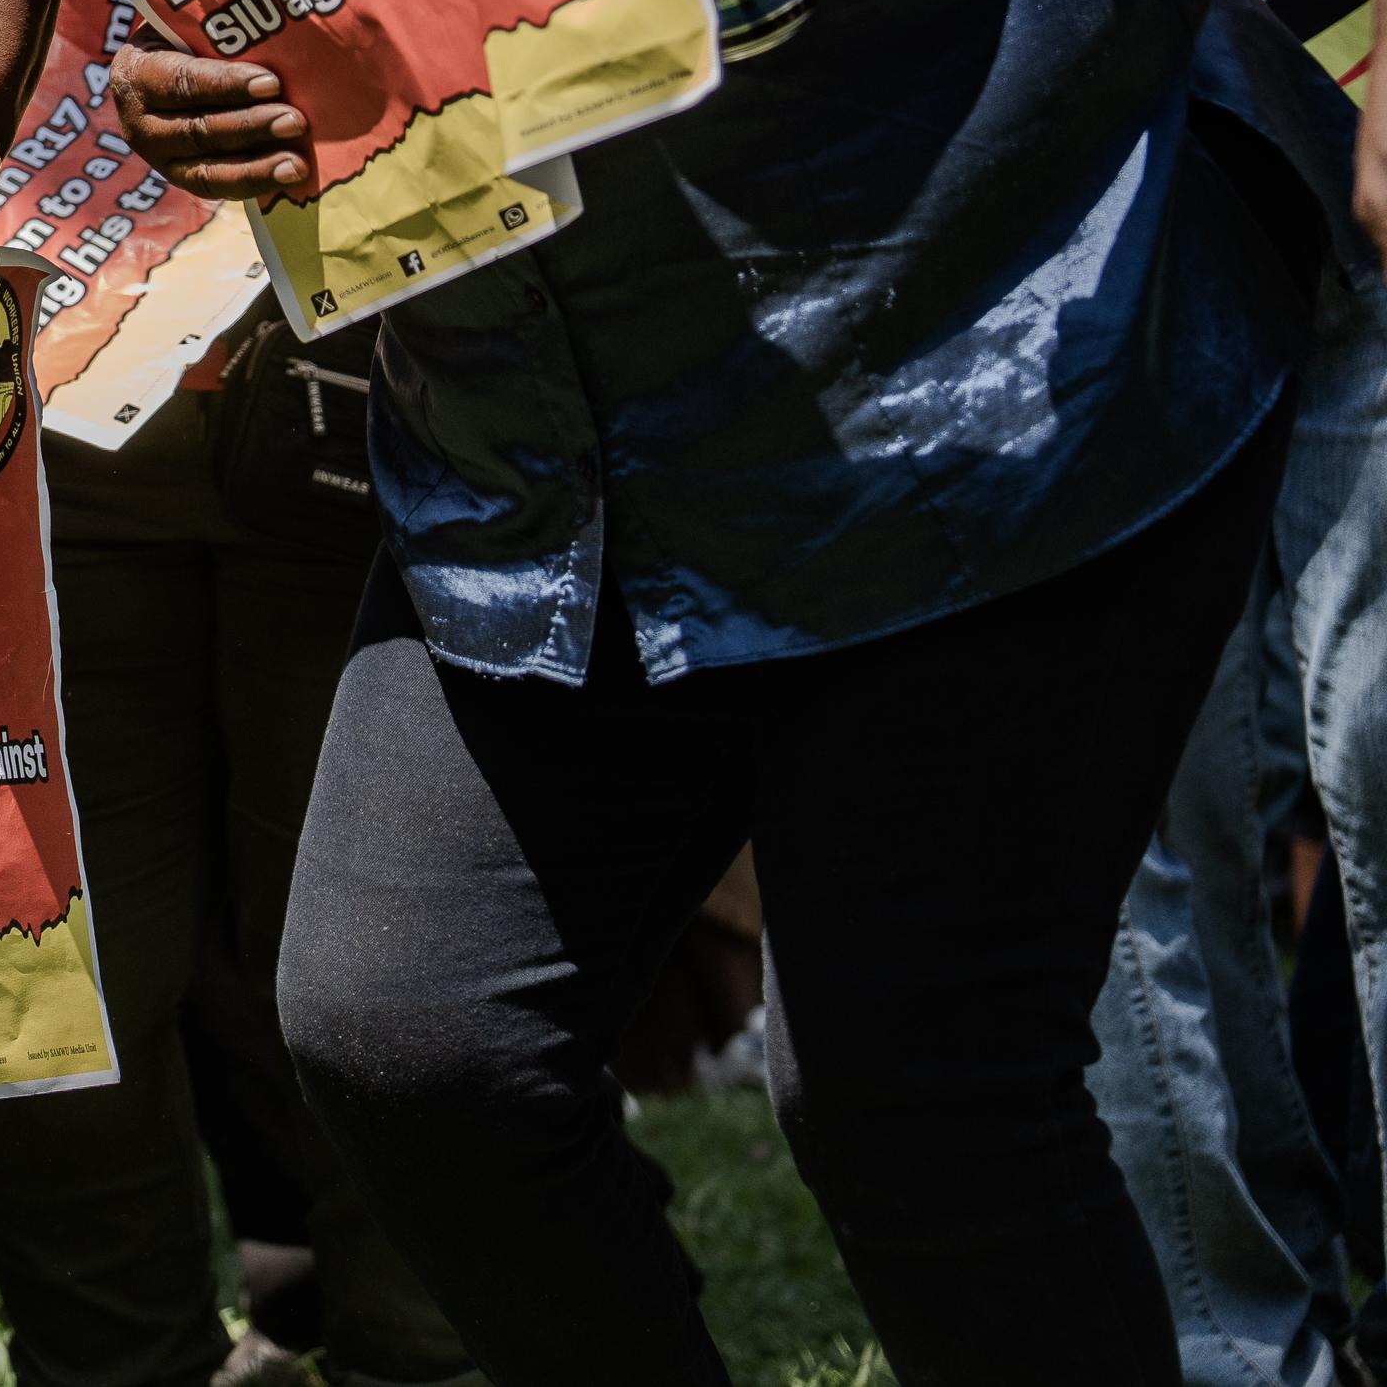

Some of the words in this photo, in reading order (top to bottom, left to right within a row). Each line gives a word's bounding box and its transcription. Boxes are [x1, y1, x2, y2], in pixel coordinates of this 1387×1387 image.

[11, 63, 112, 169] R17.4
[39, 178, 93, 219] to
[85, 157, 119, 180] a
[60, 214, 133, 276] his
[1, 289, 20, 347] WORKERS'
[10, 353, 24, 396] UNION
[4, 438, 14, 451] TO
[11, 422, 22, 438] ALL
[27, 1050, 44, 1061] Issued
[50, 1047, 70, 1058] SAMWU
[70, 1045, 86, 1055] Media
[86, 1043, 97, 1053] Unit
